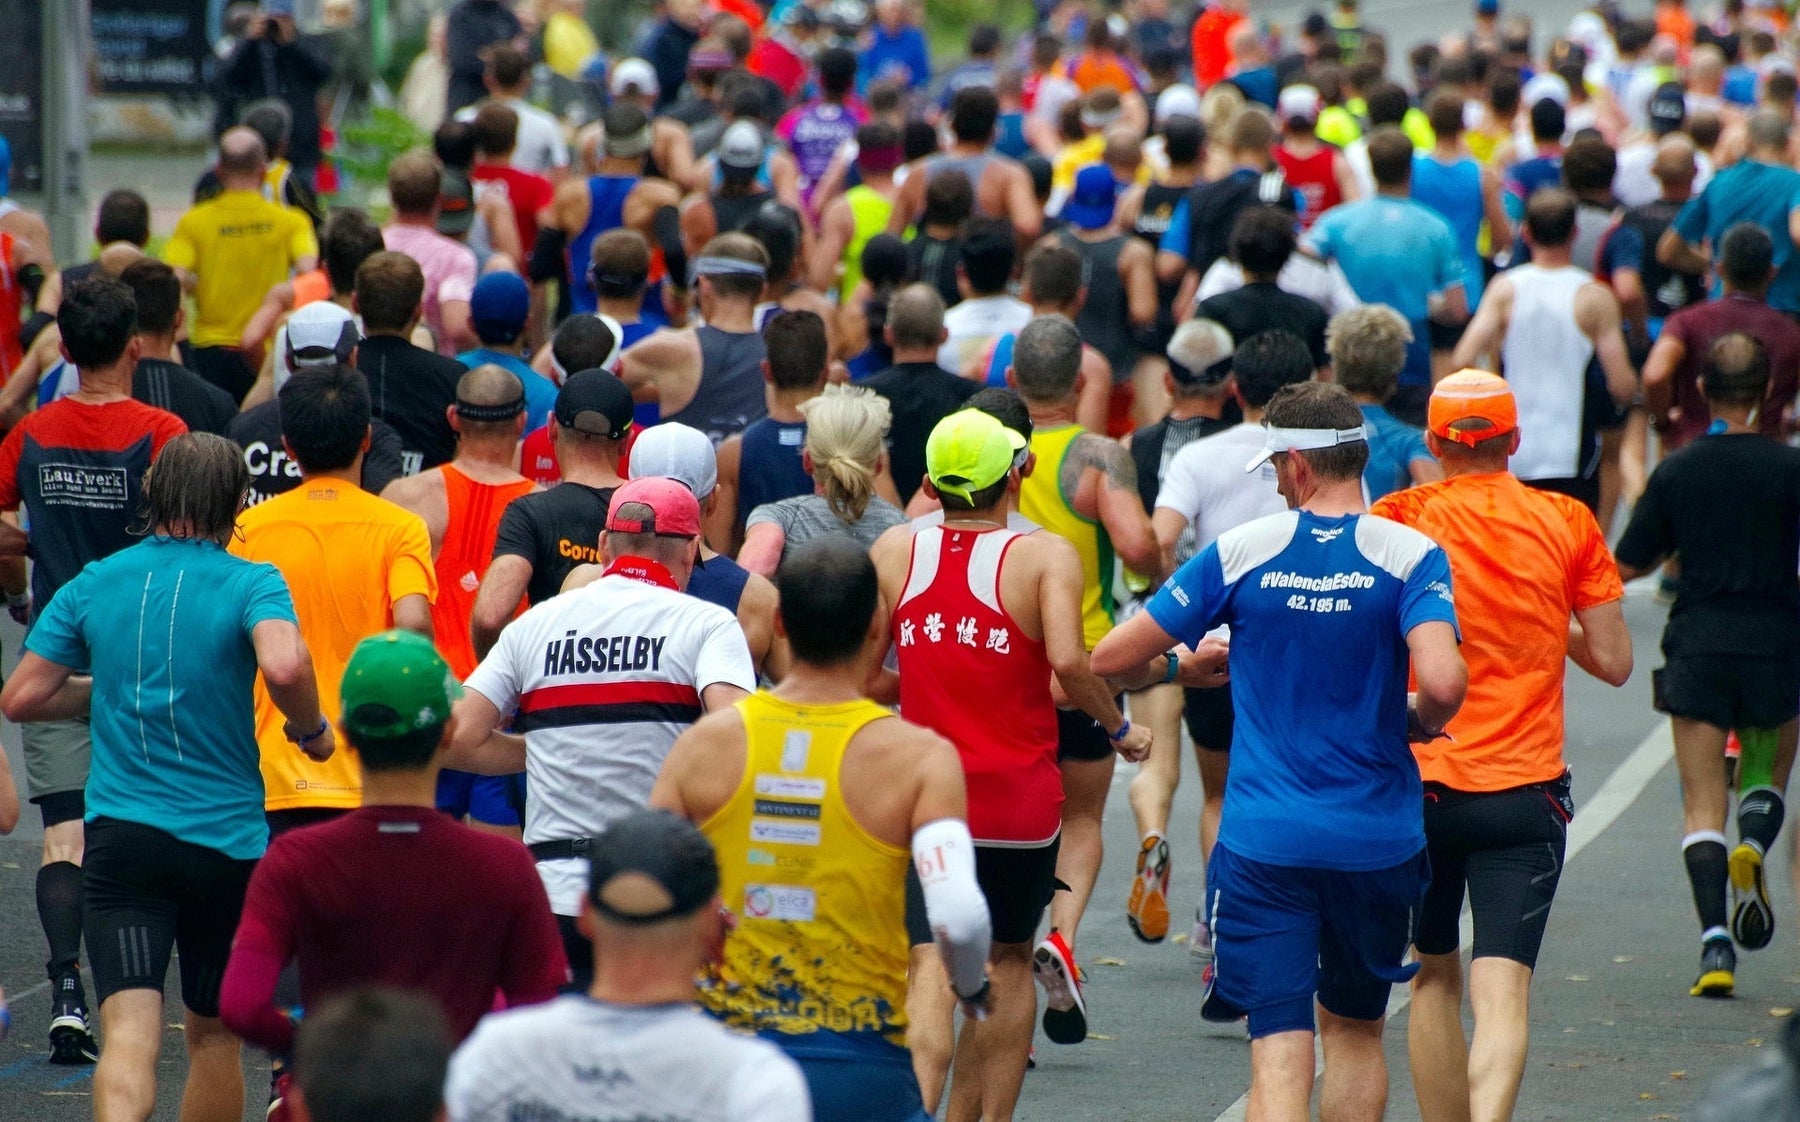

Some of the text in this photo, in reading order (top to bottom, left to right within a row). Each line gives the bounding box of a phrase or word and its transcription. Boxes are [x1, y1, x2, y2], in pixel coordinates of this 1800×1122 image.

[43, 468, 122, 487] Laufwerk
[1260, 571, 1375, 592] #ValenciaEsOro
[1287, 594, 1351, 613] 42.195 m.
[543, 629, 667, 677] HÄSSELBY
[778, 894, 808, 908] elca
